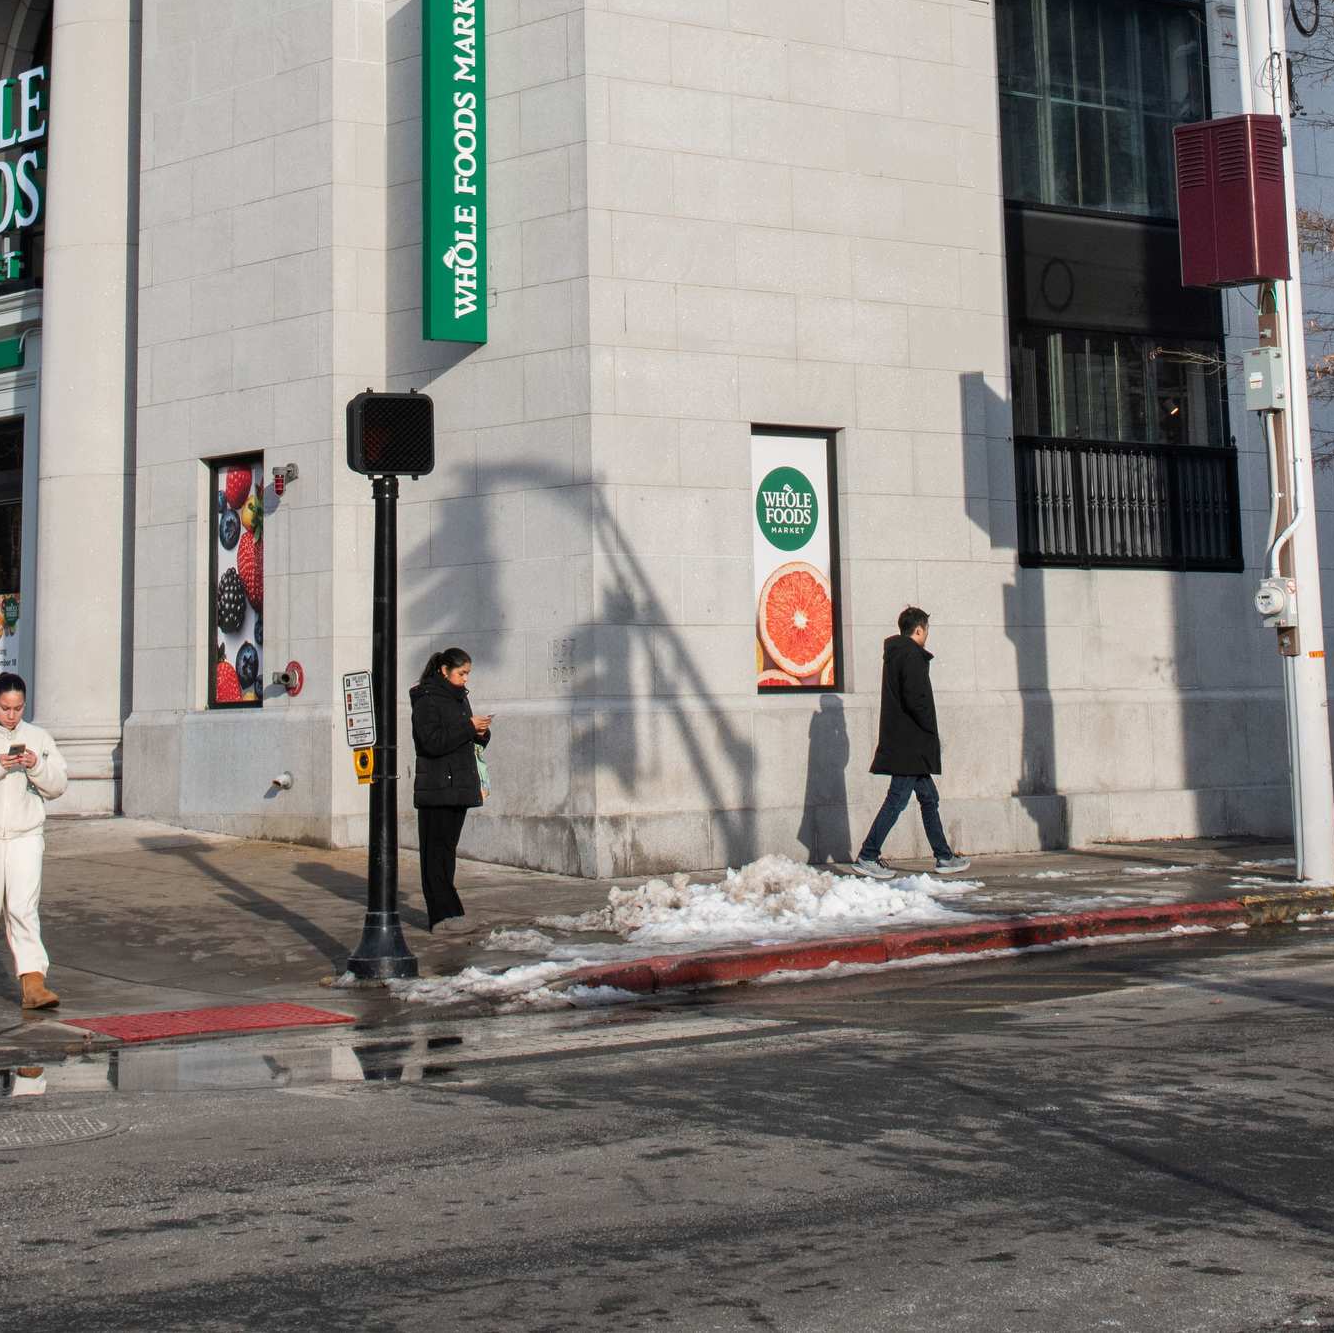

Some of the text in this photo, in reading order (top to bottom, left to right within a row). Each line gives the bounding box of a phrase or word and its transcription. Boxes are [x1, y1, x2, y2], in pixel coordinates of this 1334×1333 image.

[454, 91, 477, 195] FOODS
[443, 205, 478, 319] WHOLE
[762, 483, 812, 508] WHOLE
[766, 508, 811, 524] FOODS
